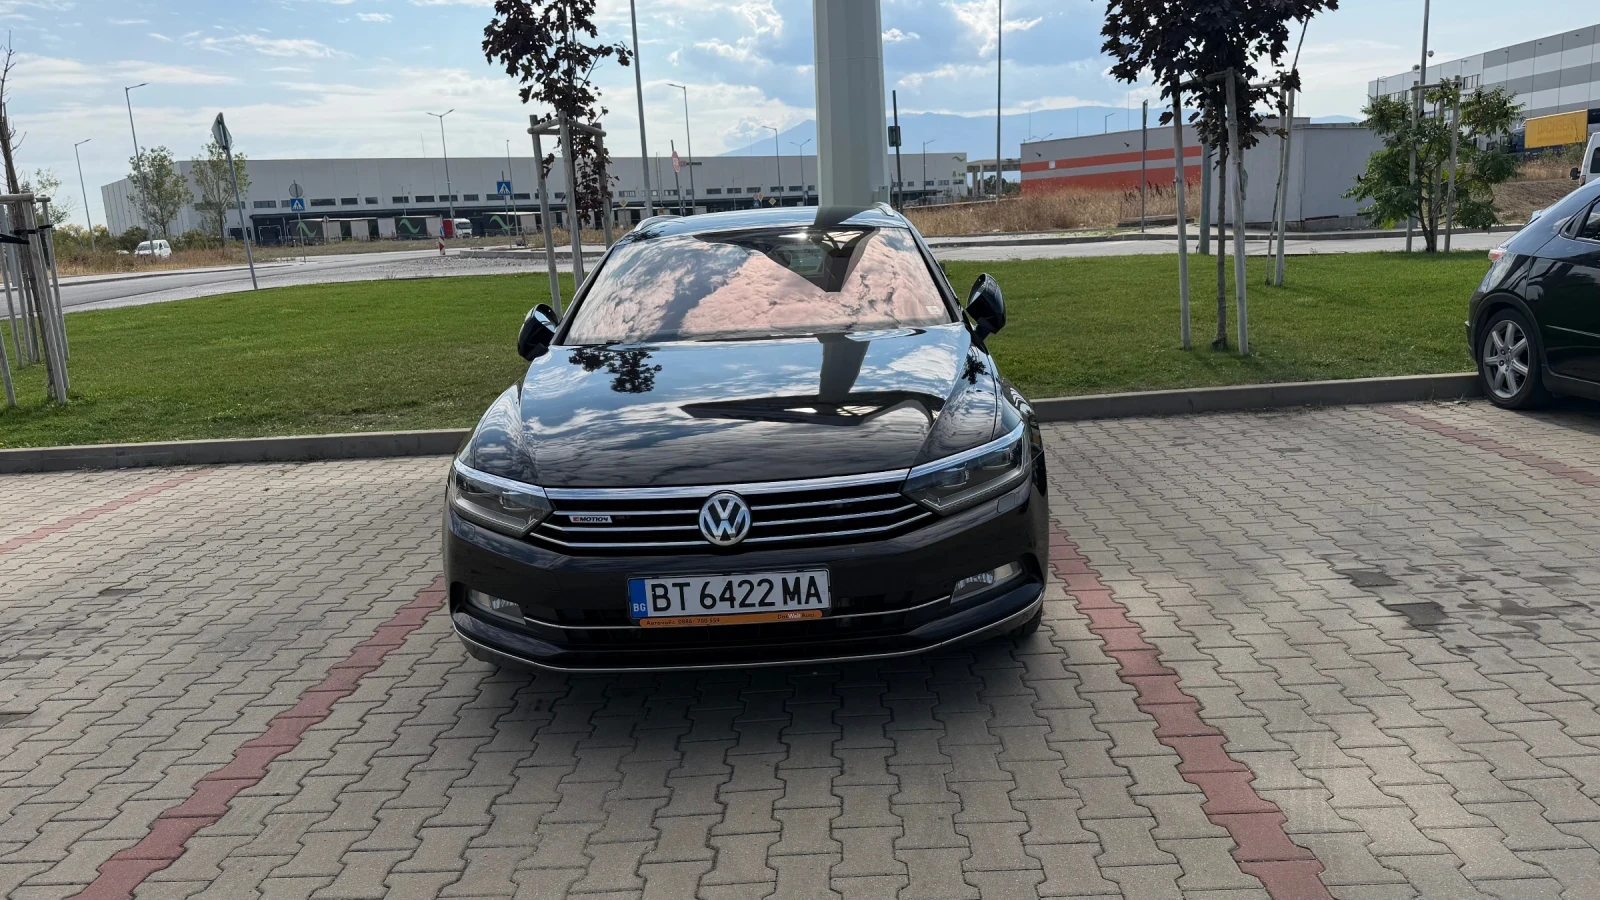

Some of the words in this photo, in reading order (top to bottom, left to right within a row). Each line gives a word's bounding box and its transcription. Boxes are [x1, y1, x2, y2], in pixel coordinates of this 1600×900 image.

[652, 582, 690, 612] BT
[700, 579, 775, 609] 6422
[782, 576, 822, 605] MA
[633, 603, 646, 612] BG
